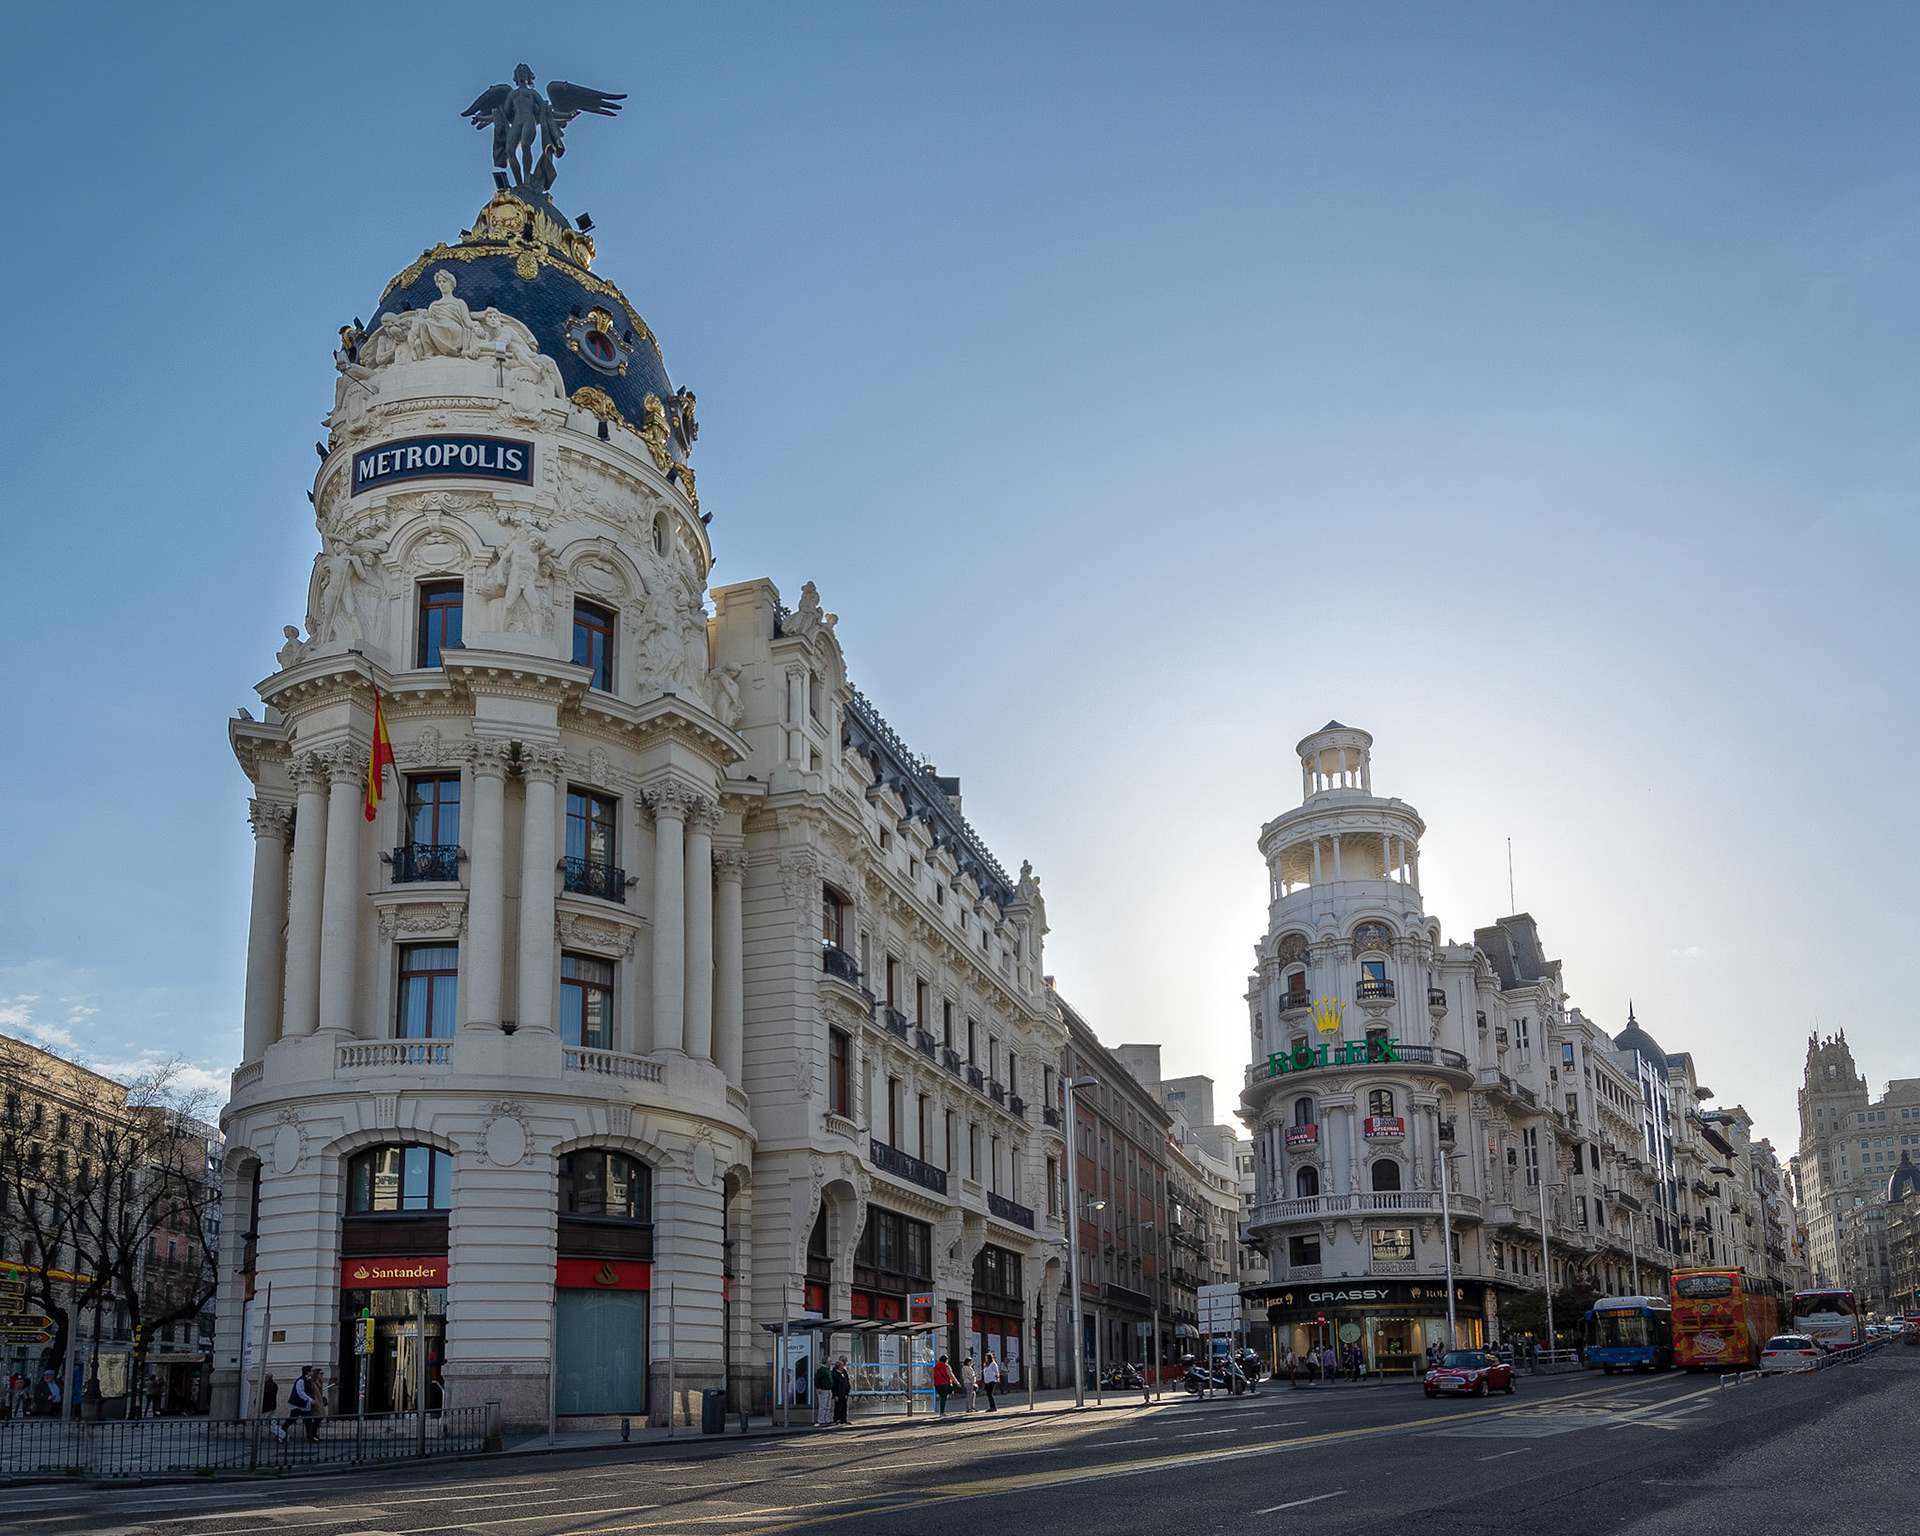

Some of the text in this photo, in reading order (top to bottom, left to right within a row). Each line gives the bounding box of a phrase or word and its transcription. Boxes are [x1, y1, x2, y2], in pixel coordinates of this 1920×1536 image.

[358, 444, 522, 482] METROPOLIS
[1267, 1038, 1402, 1076] ROLEX
[372, 1265, 436, 1279] Santander
[1308, 1289, 1389, 1302] GRASSY
